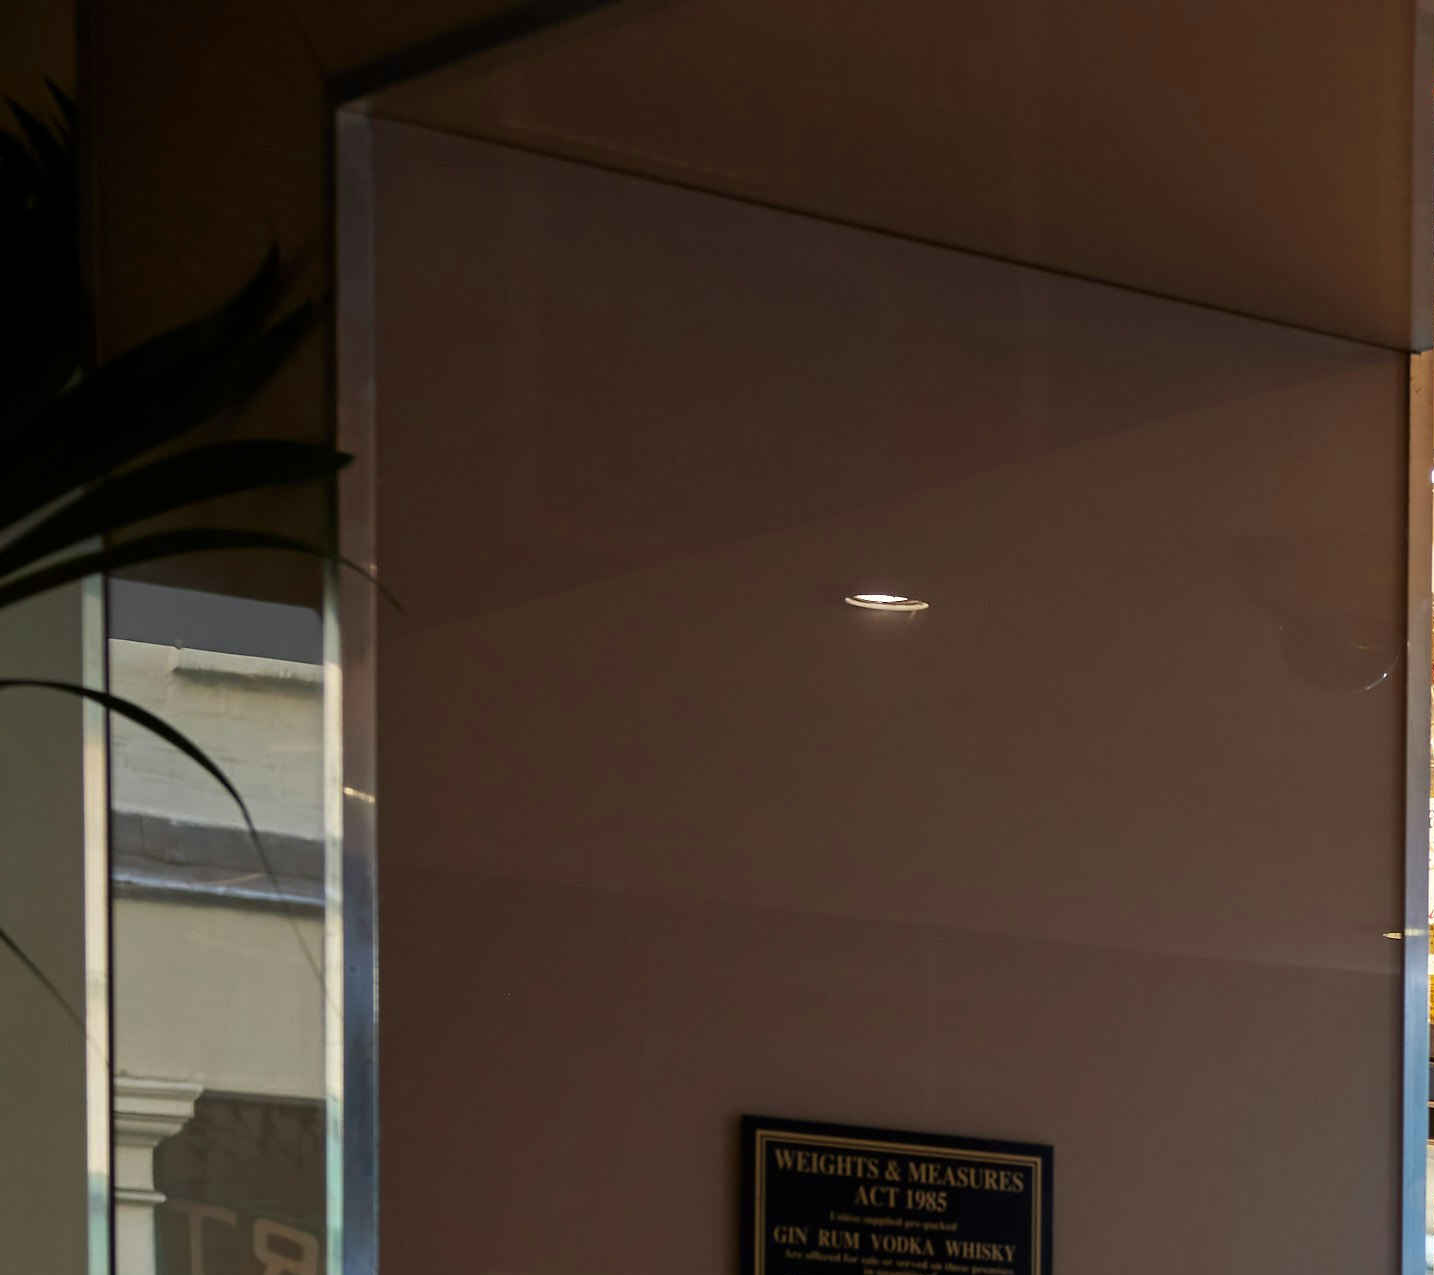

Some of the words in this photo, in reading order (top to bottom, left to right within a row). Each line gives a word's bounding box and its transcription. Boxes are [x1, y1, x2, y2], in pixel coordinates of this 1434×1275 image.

[774, 1149, 879, 1180] WEIGHTS
[885, 1160, 901, 1182] &
[908, 1161, 1024, 1193] MEASURES
[855, 1185, 899, 1209] ACT
[906, 1189, 948, 1212] 1985
[774, 1226, 808, 1246] GIN
[818, 1230, 861, 1250] RUM
[871, 1234, 935, 1256] VODKA
[946, 1239, 1017, 1263] WHISKY
